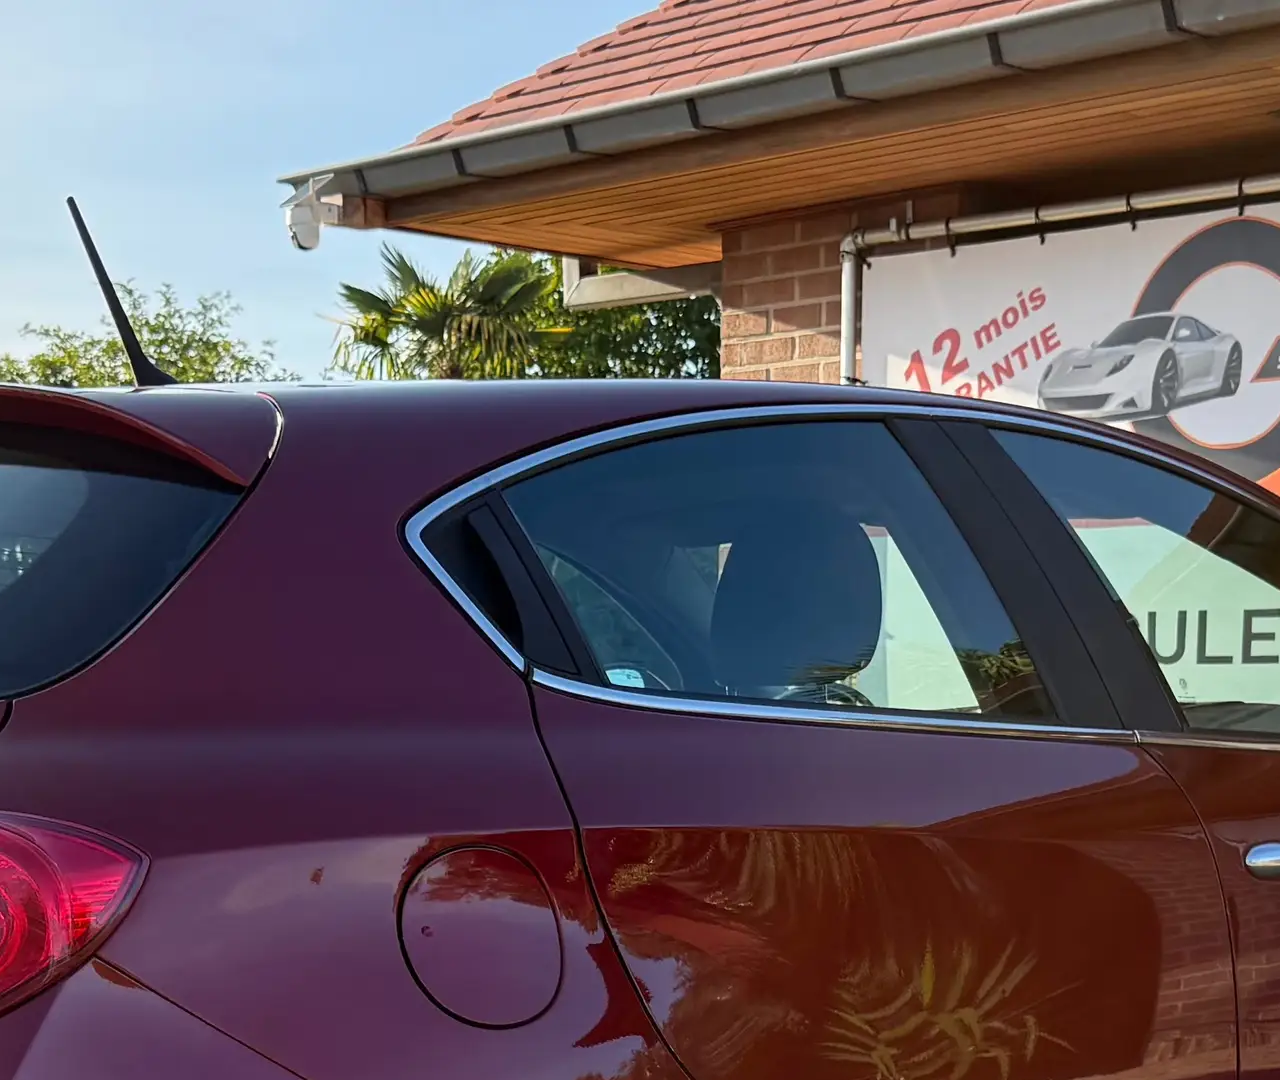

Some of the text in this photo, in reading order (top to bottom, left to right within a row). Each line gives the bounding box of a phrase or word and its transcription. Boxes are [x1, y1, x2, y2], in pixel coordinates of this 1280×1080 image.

[904, 287, 1047, 393] 12 mois
[955, 322, 1062, 399] RANTIE
